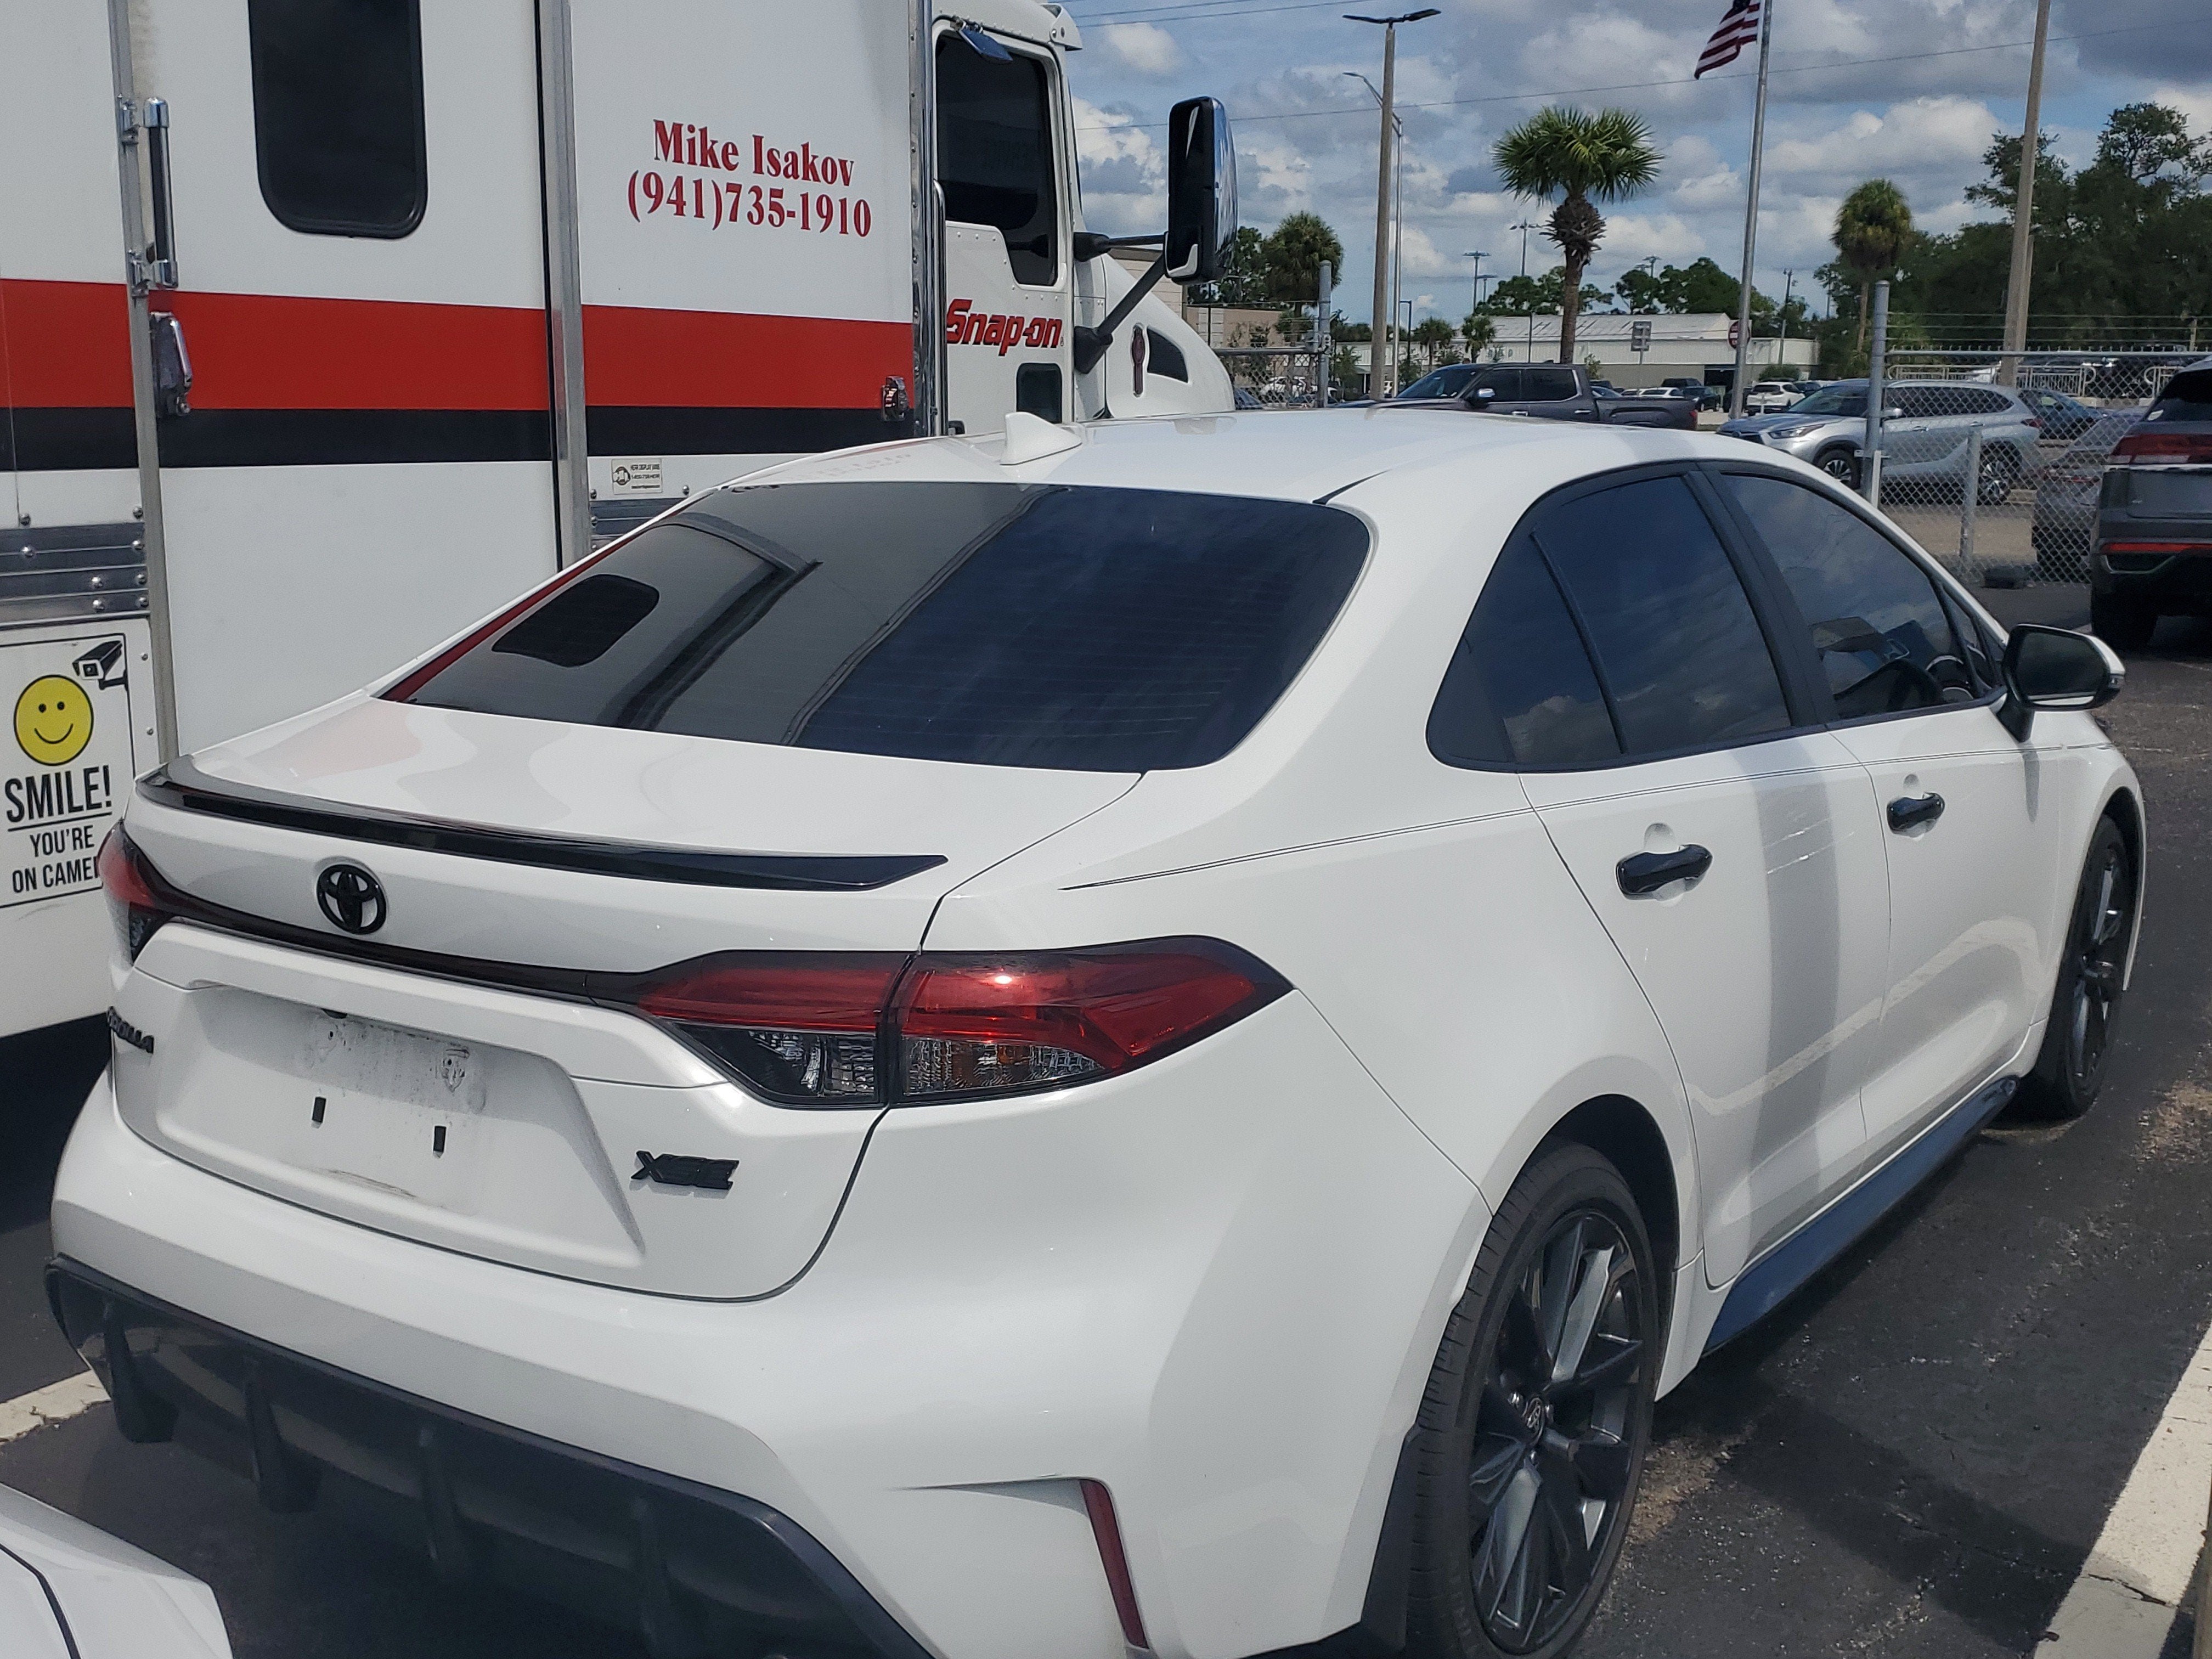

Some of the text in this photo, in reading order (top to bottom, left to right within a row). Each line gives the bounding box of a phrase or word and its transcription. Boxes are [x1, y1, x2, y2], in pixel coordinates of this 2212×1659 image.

[653, 119, 855, 187] Mike Isakov
[628, 170, 871, 238] (941)735-1910
[947, 298, 1063, 357] Snap-on
[4, 764, 112, 823] SMILE!
[29, 824, 95, 857] YOU'RE
[12, 856, 100, 893] ON CAME
